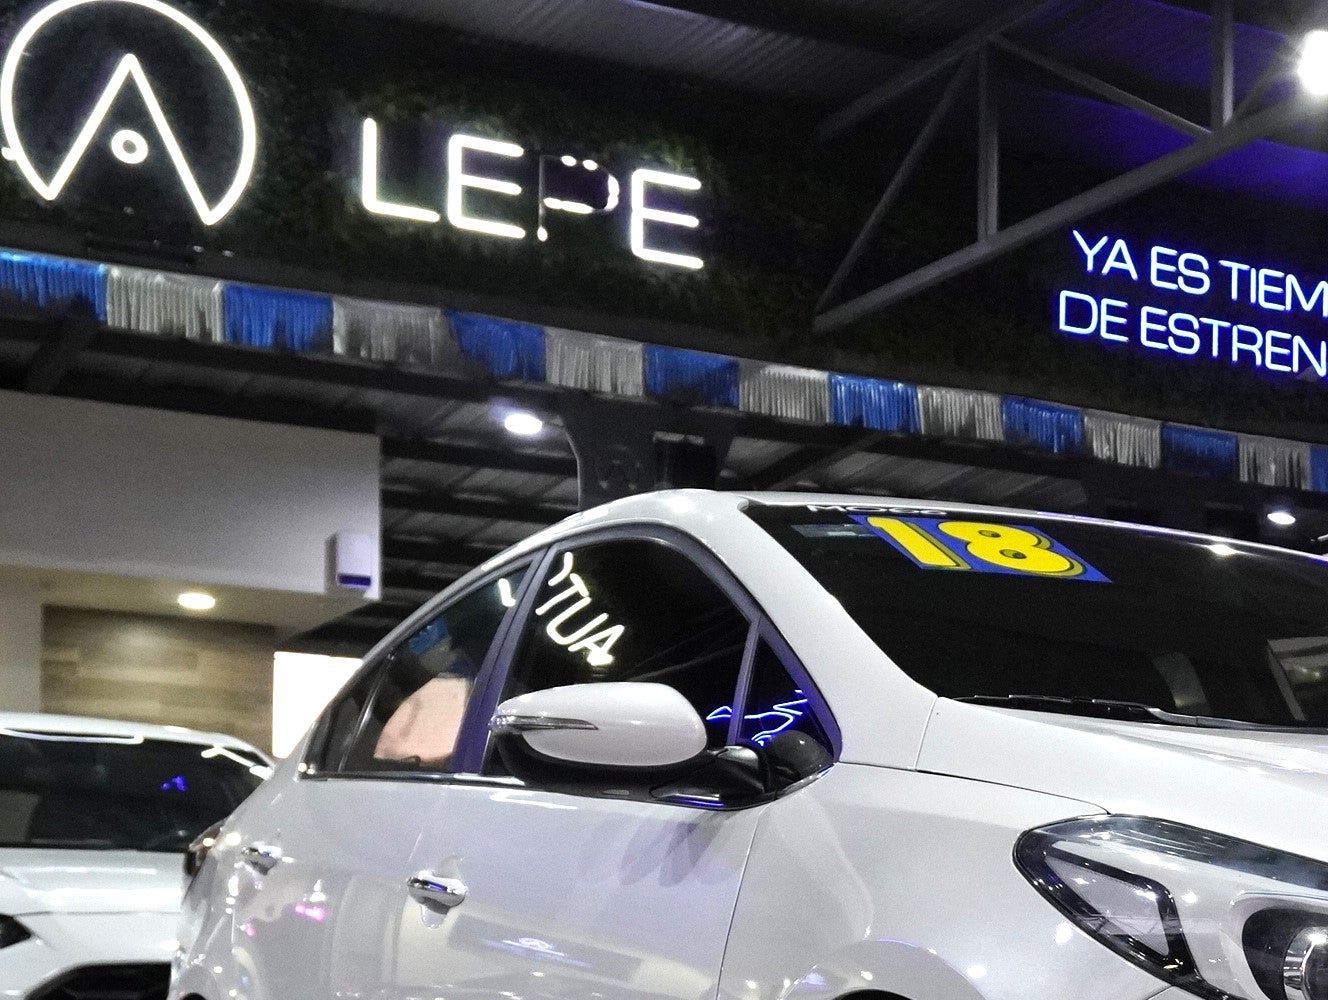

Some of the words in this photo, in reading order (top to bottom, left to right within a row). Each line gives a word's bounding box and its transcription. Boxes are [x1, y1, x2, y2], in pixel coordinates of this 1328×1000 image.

[361, 117, 704, 269] LEPE
[1072, 229, 1138, 281] YA
[1150, 245, 1211, 295] ES
[1058, 289, 1130, 343] DE
[867, 516, 1084, 576] 18
